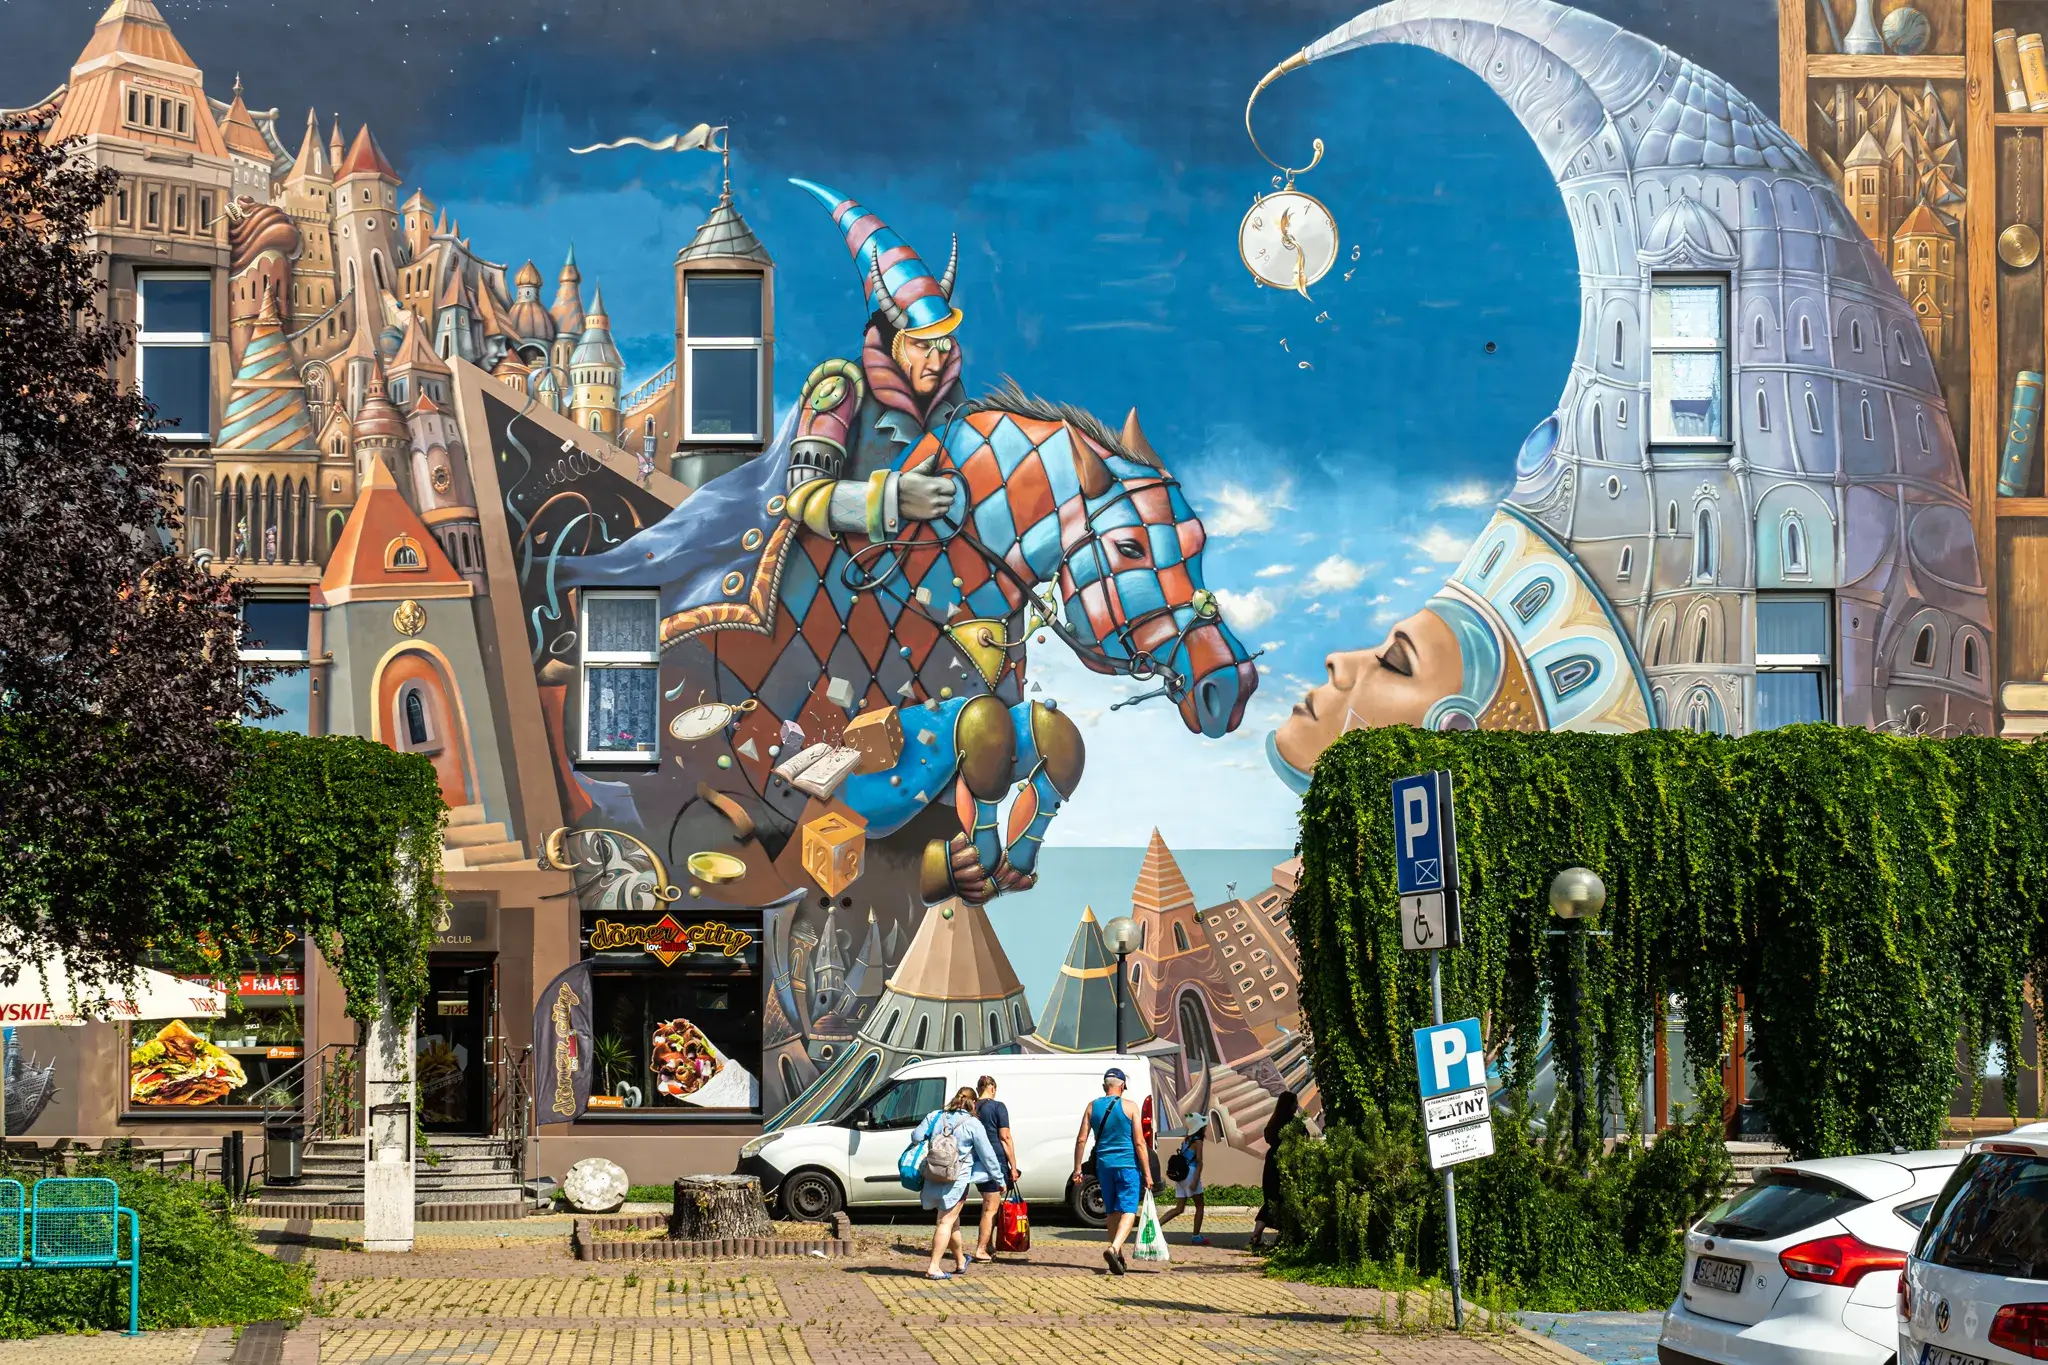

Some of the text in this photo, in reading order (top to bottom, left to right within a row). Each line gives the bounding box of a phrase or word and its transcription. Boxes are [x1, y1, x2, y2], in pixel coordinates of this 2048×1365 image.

[818, 818, 848, 836] 7
[1402, 785, 1430, 859] P
[804, 839, 829, 885] 12
[845, 849, 859, 881] 3
[447, 936, 472, 944] CLUB
[590, 919, 753, 957] döner city
[1430, 1027, 1467, 1090] P
[1473, 1089, 1484, 1097] 24h
[1428, 1097, 1484, 1123] ATNY
